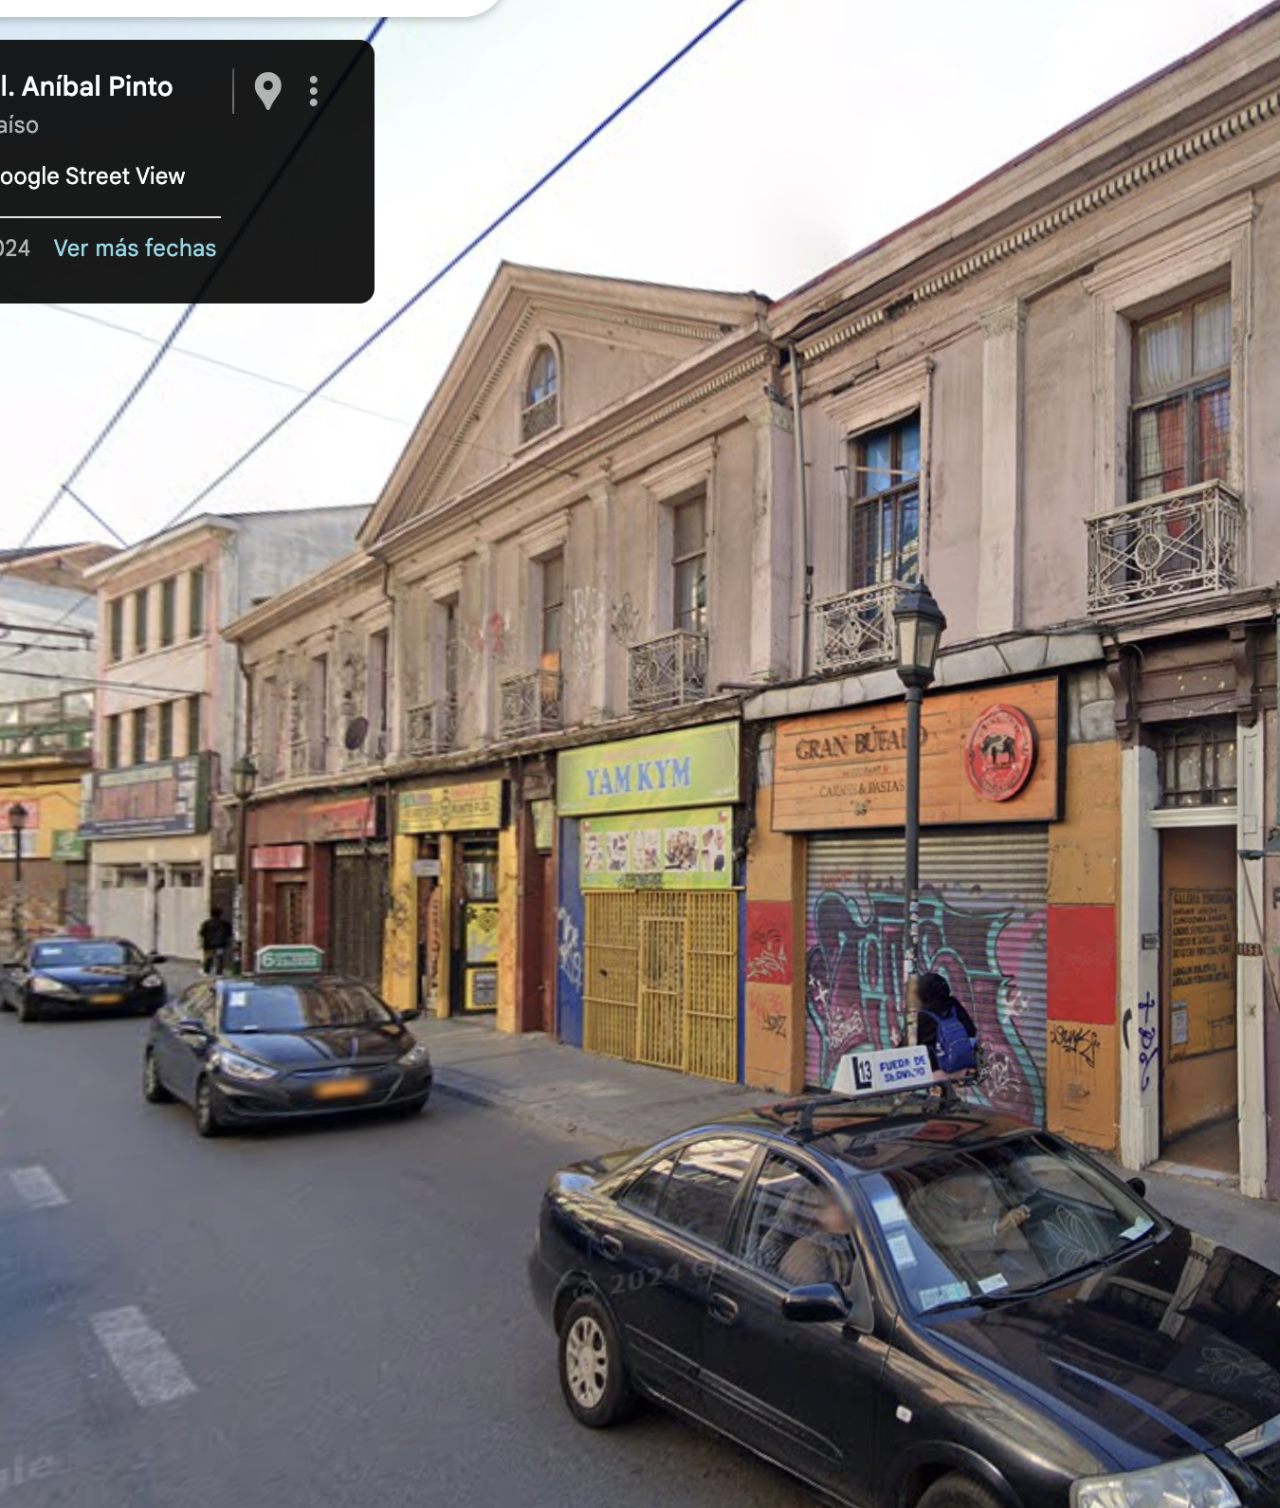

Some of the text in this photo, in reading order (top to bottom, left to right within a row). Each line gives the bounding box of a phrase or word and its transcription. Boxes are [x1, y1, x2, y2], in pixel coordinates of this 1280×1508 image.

[795, 735, 848, 760] GRAN
[585, 757, 692, 797] YAM KYM
